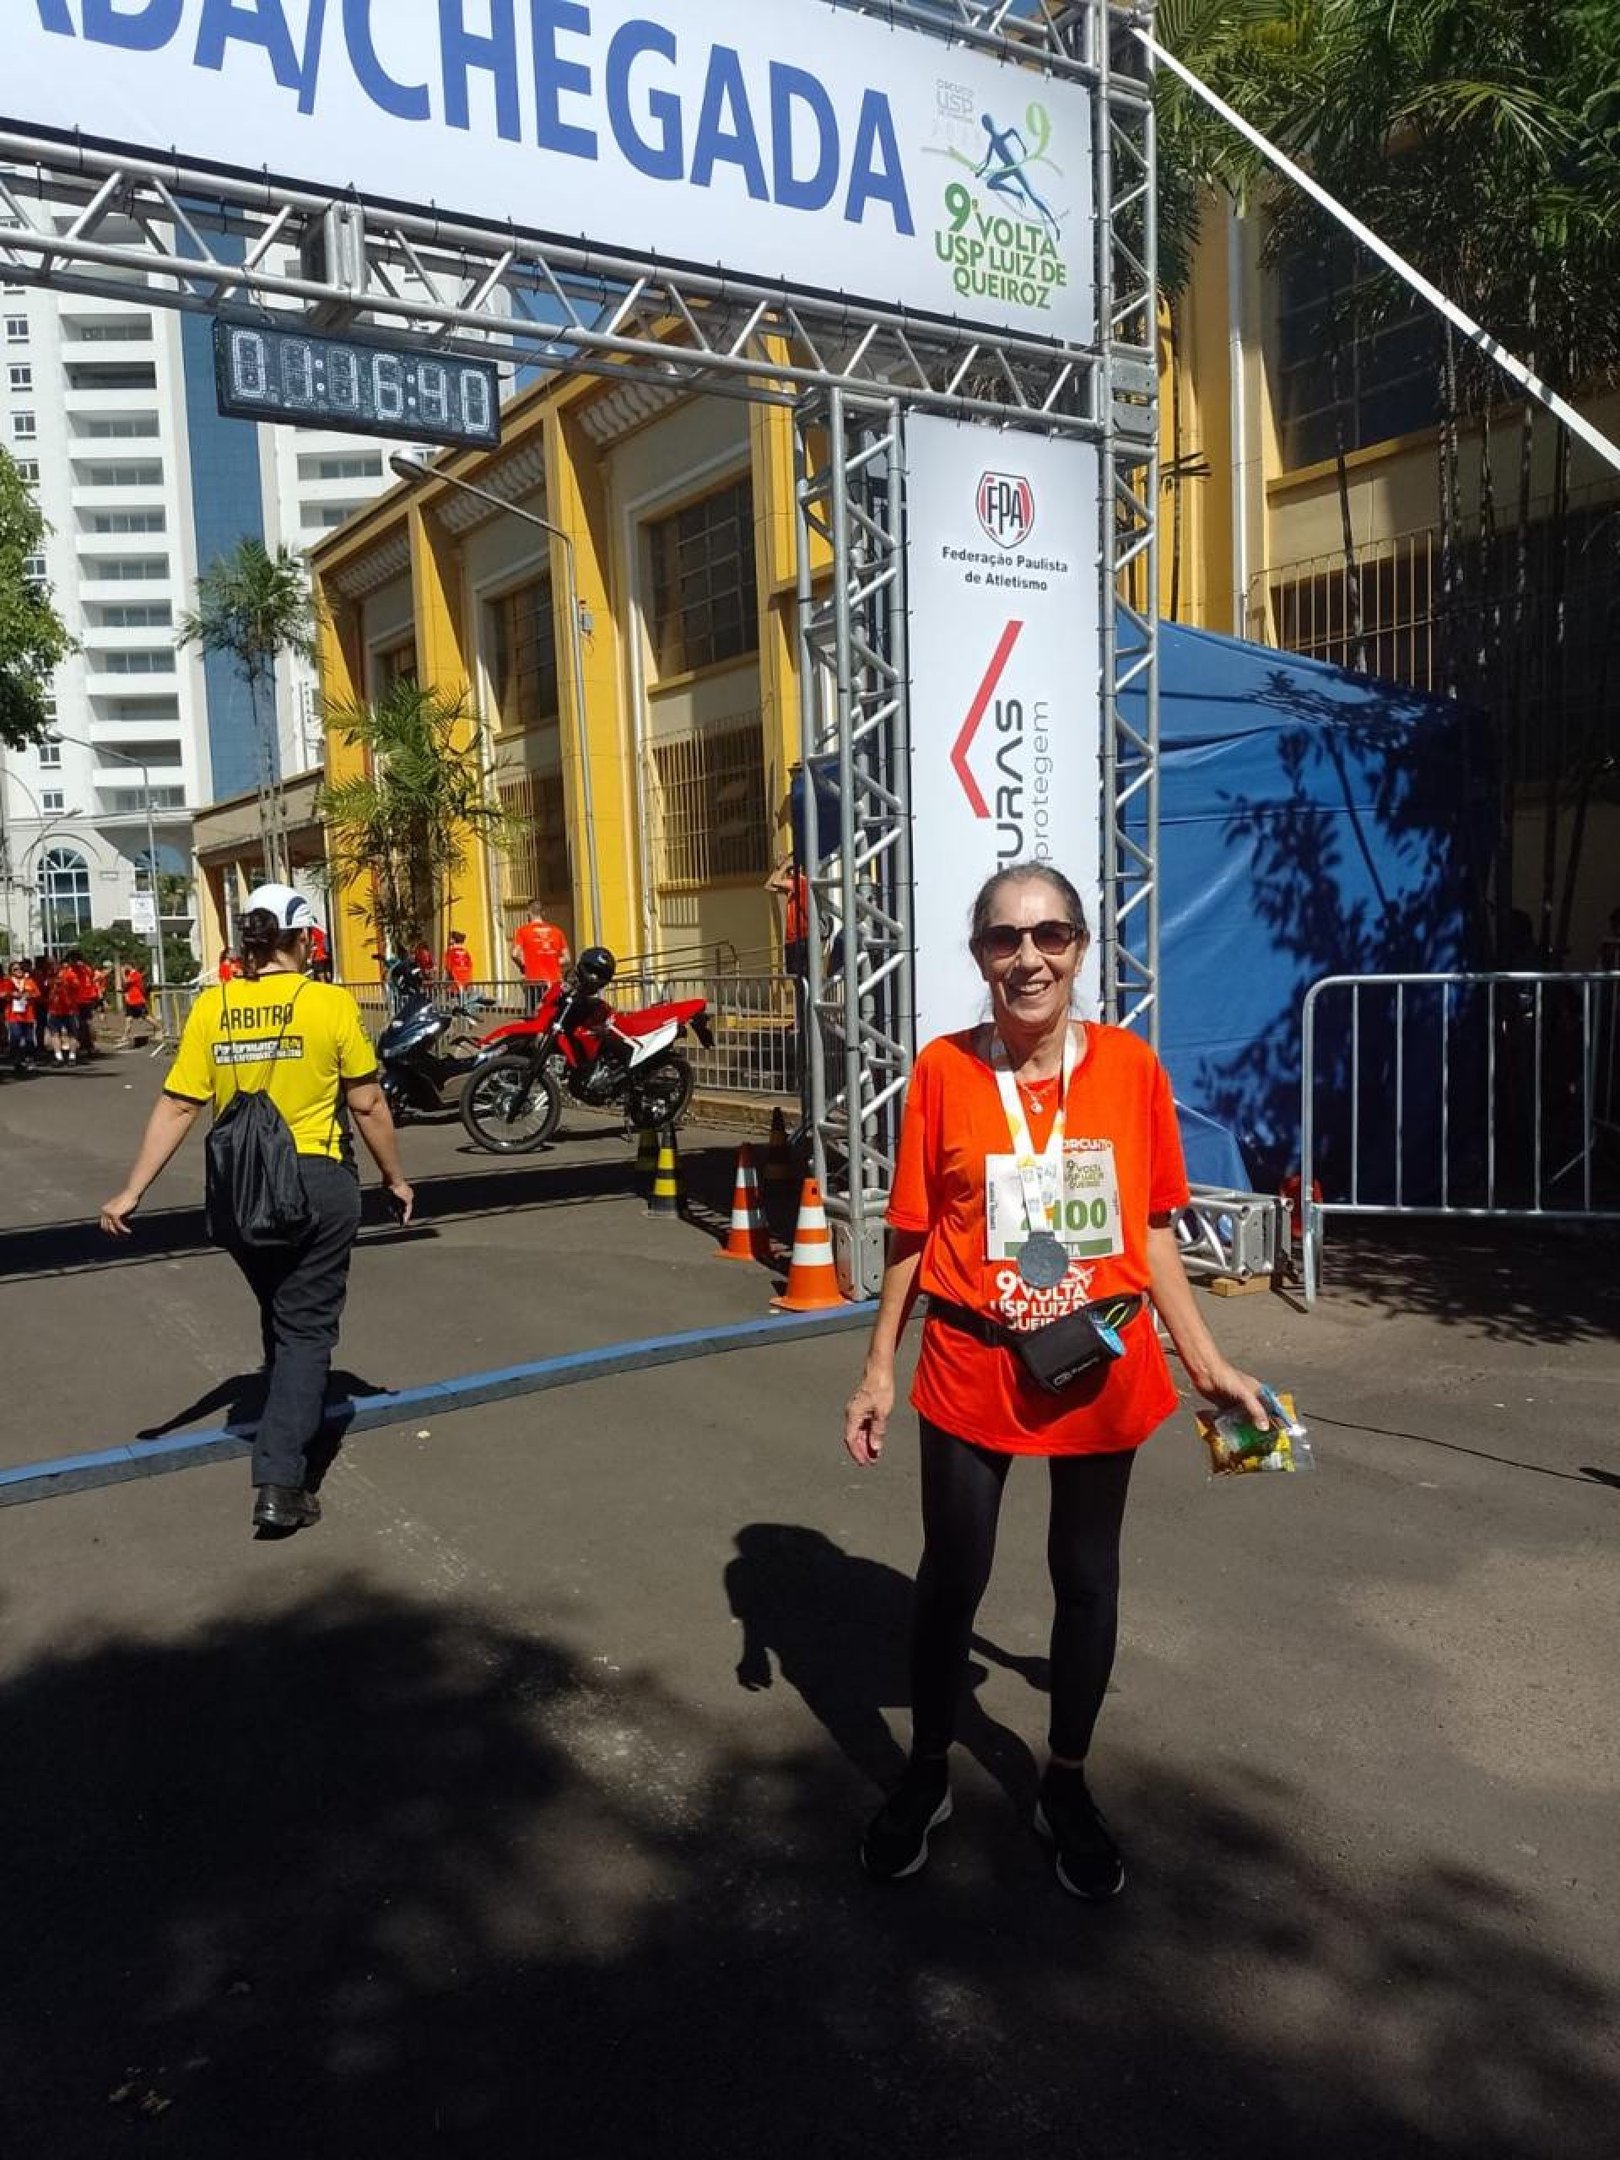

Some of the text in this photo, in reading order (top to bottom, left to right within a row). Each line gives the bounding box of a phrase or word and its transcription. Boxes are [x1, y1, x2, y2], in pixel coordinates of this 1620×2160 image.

[976, 212, 1058, 260] VOLTA
[935, 230, 1067, 287] USP LUIZ DE
[953, 266, 1051, 310] QUEIROZ
[986, 481, 1024, 535] FPA
[942, 545, 1069, 573] Federação Paulista
[964, 569, 1047, 591] de Atletismo
[1031, 701, 1054, 860] protegem
[1020, 1198, 1107, 1231] 100
[1031, 1300, 1072, 1318] LUIZ
